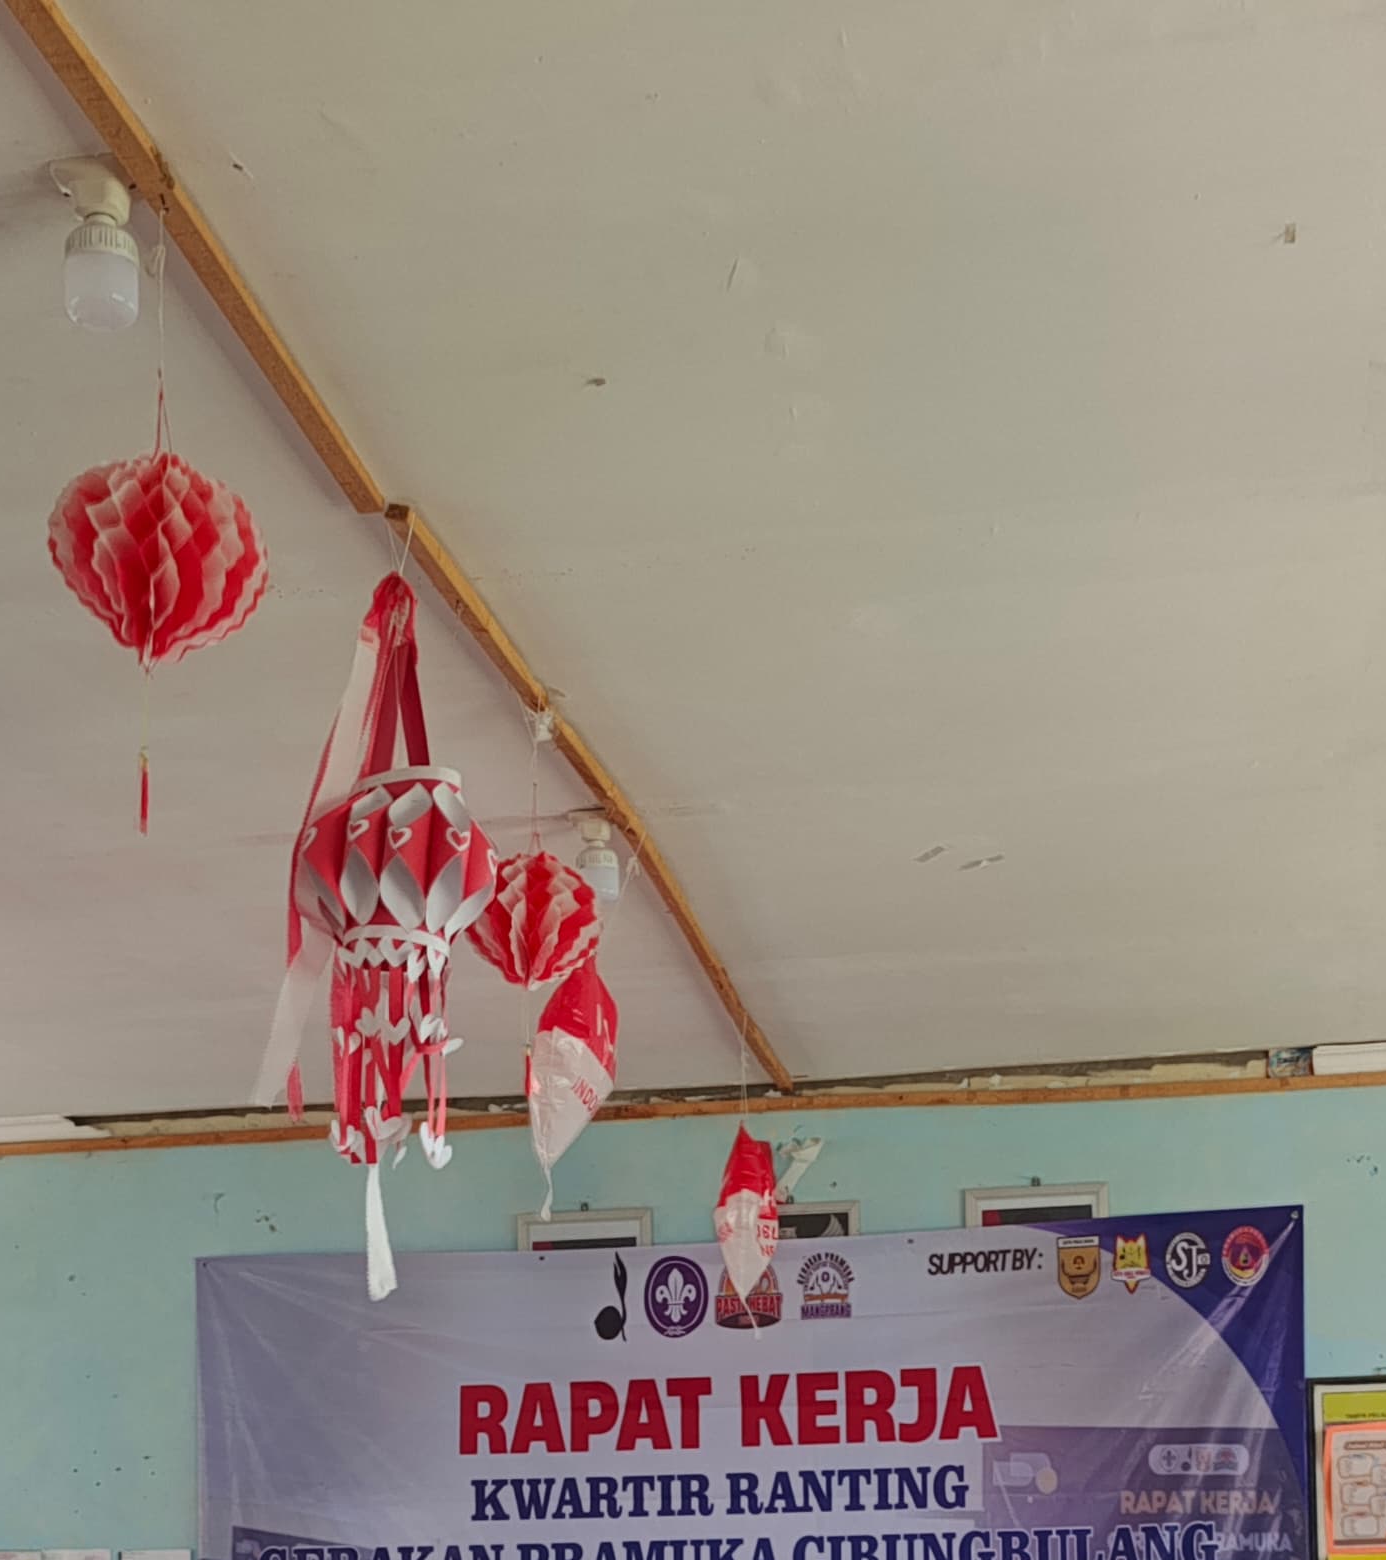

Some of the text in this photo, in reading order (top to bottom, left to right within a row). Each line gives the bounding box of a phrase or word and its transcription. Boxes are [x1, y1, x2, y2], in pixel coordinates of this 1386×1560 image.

[928, 1251, 1010, 1275] SUPPORT
[459, 1366, 1000, 1455] RAPAT KERJA
[471, 1465, 969, 1521] KWARTIR RANTING
[1120, 1489, 1278, 1515] RAPAT KERJA
[1216, 1531, 1293, 1552] RAMUKA
